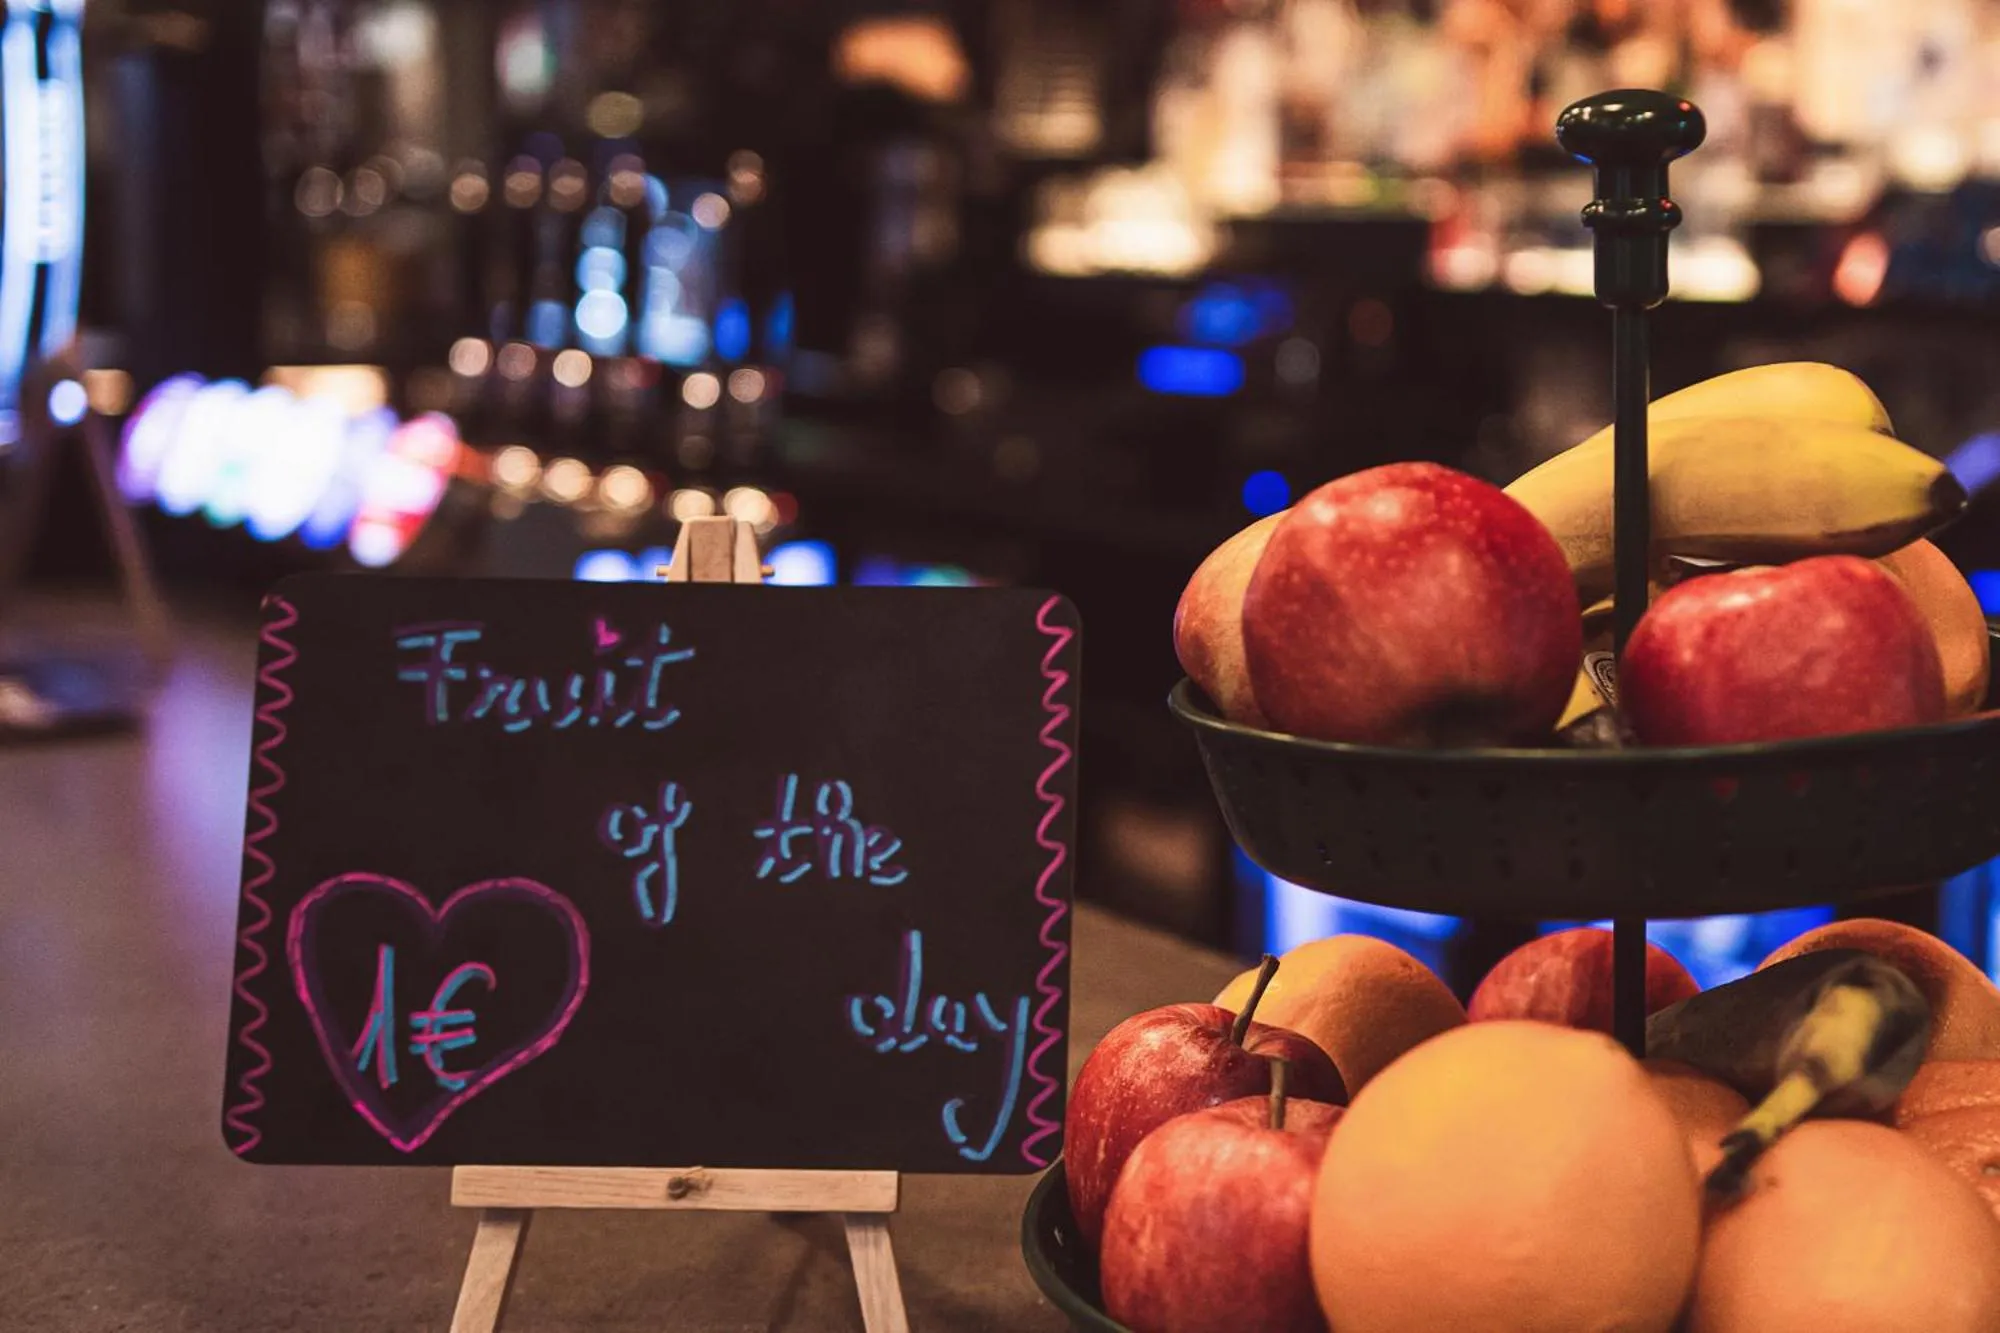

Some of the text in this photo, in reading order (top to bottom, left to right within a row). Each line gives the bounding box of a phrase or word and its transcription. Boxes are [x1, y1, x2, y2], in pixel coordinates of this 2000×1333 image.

[394, 618, 694, 731] Fruit
[602, 774, 908, 926] of the
[350, 944, 497, 1090] 1€
[847, 929, 1031, 1161] day
